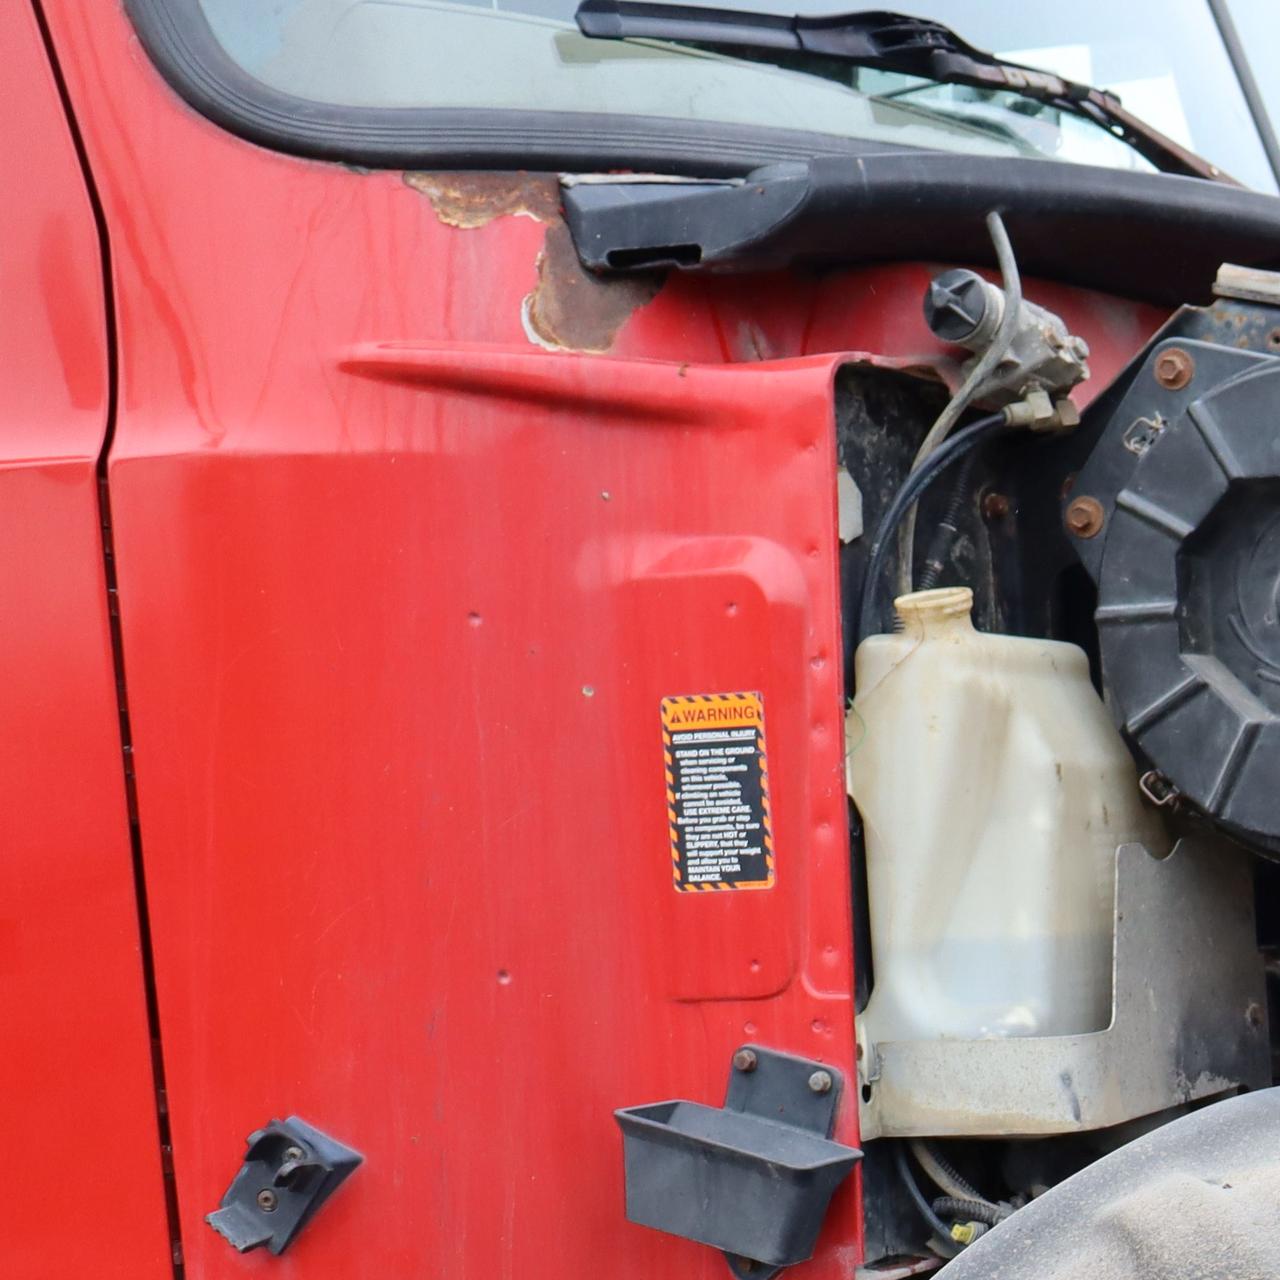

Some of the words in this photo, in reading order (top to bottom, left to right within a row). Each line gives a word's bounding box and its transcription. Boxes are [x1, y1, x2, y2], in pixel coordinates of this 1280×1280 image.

[683, 706, 754, 722] WARNING
[672, 733, 693, 741] AVOID
[694, 731, 730, 740] PERSONAL
[730, 729, 756, 737] INJURY
[675, 750, 698, 758] STAND
[711, 748, 724, 756] THE
[725, 746, 755, 755] GROUND
[709, 764, 748, 772] components
[681, 792, 708, 800] climbing
[684, 808, 697, 816] USE
[699, 806, 730, 815] EXTREME
[732, 805, 752, 813] CARE.
[712, 816, 727, 824] grab
[686, 841, 719, 849] SLIPPERY,
[699, 849, 723, 857] support
[740, 847, 761, 855] weight
[721, 864, 741, 872] YOUR
[689, 874, 721, 882] BALANCE.
